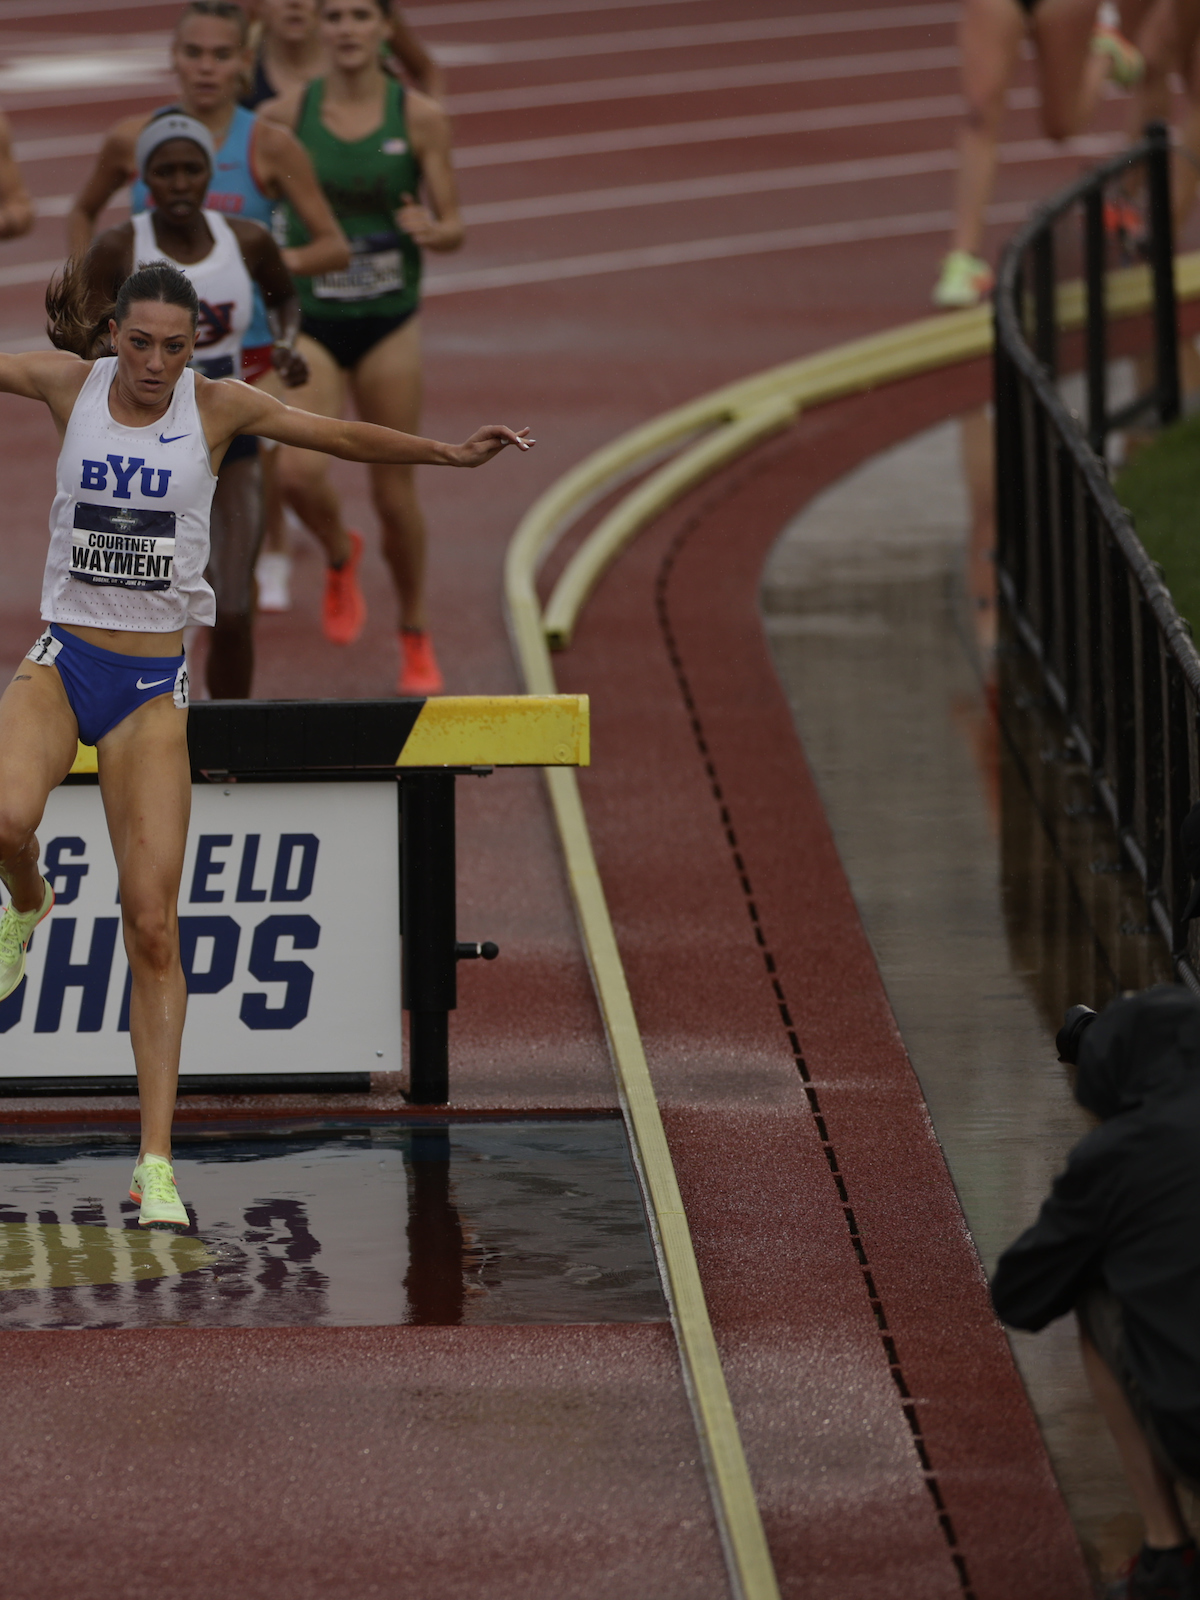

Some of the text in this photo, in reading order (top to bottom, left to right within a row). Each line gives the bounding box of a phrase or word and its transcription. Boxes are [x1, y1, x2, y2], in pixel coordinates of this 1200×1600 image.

[81, 454, 171, 499] BYU
[88, 533, 156, 553] COURTNEY
[72, 545, 173, 578] WAYMENT
